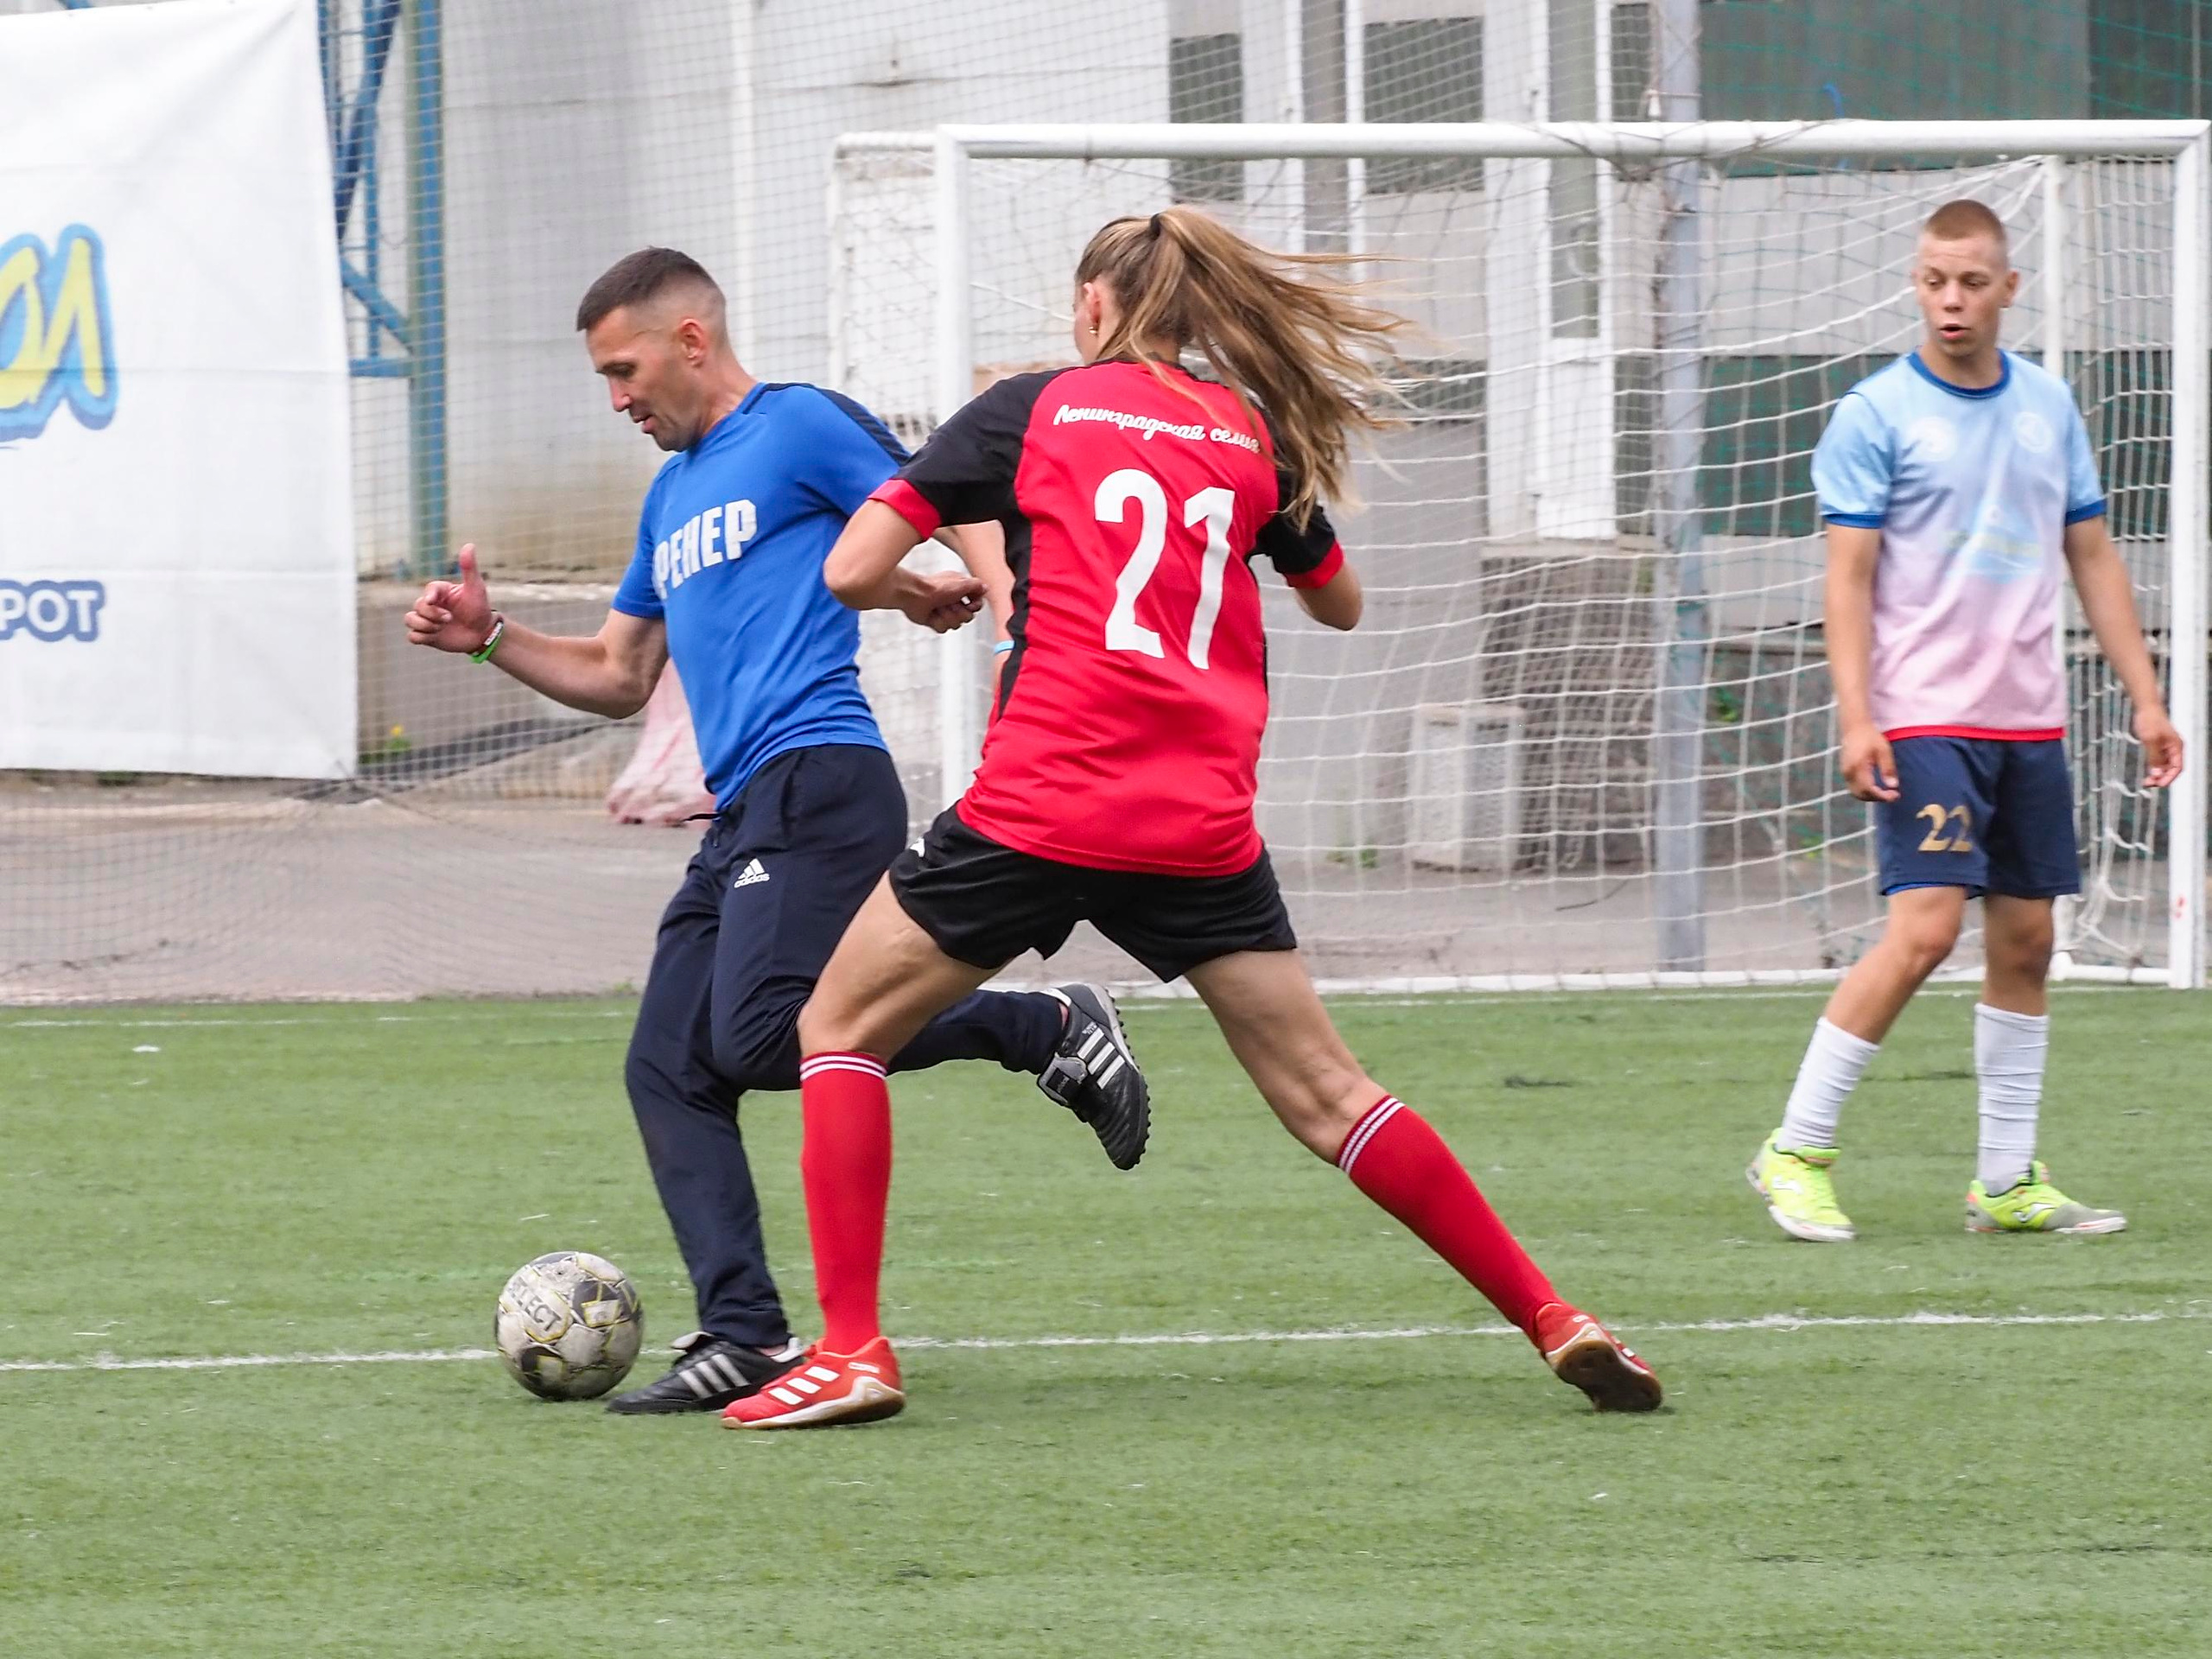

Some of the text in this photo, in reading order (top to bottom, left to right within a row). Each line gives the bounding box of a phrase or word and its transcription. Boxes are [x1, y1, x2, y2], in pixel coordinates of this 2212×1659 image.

[1094, 468, 1236, 670] 21
[1916, 804, 1974, 852] 22
[734, 873, 771, 888] adidas
